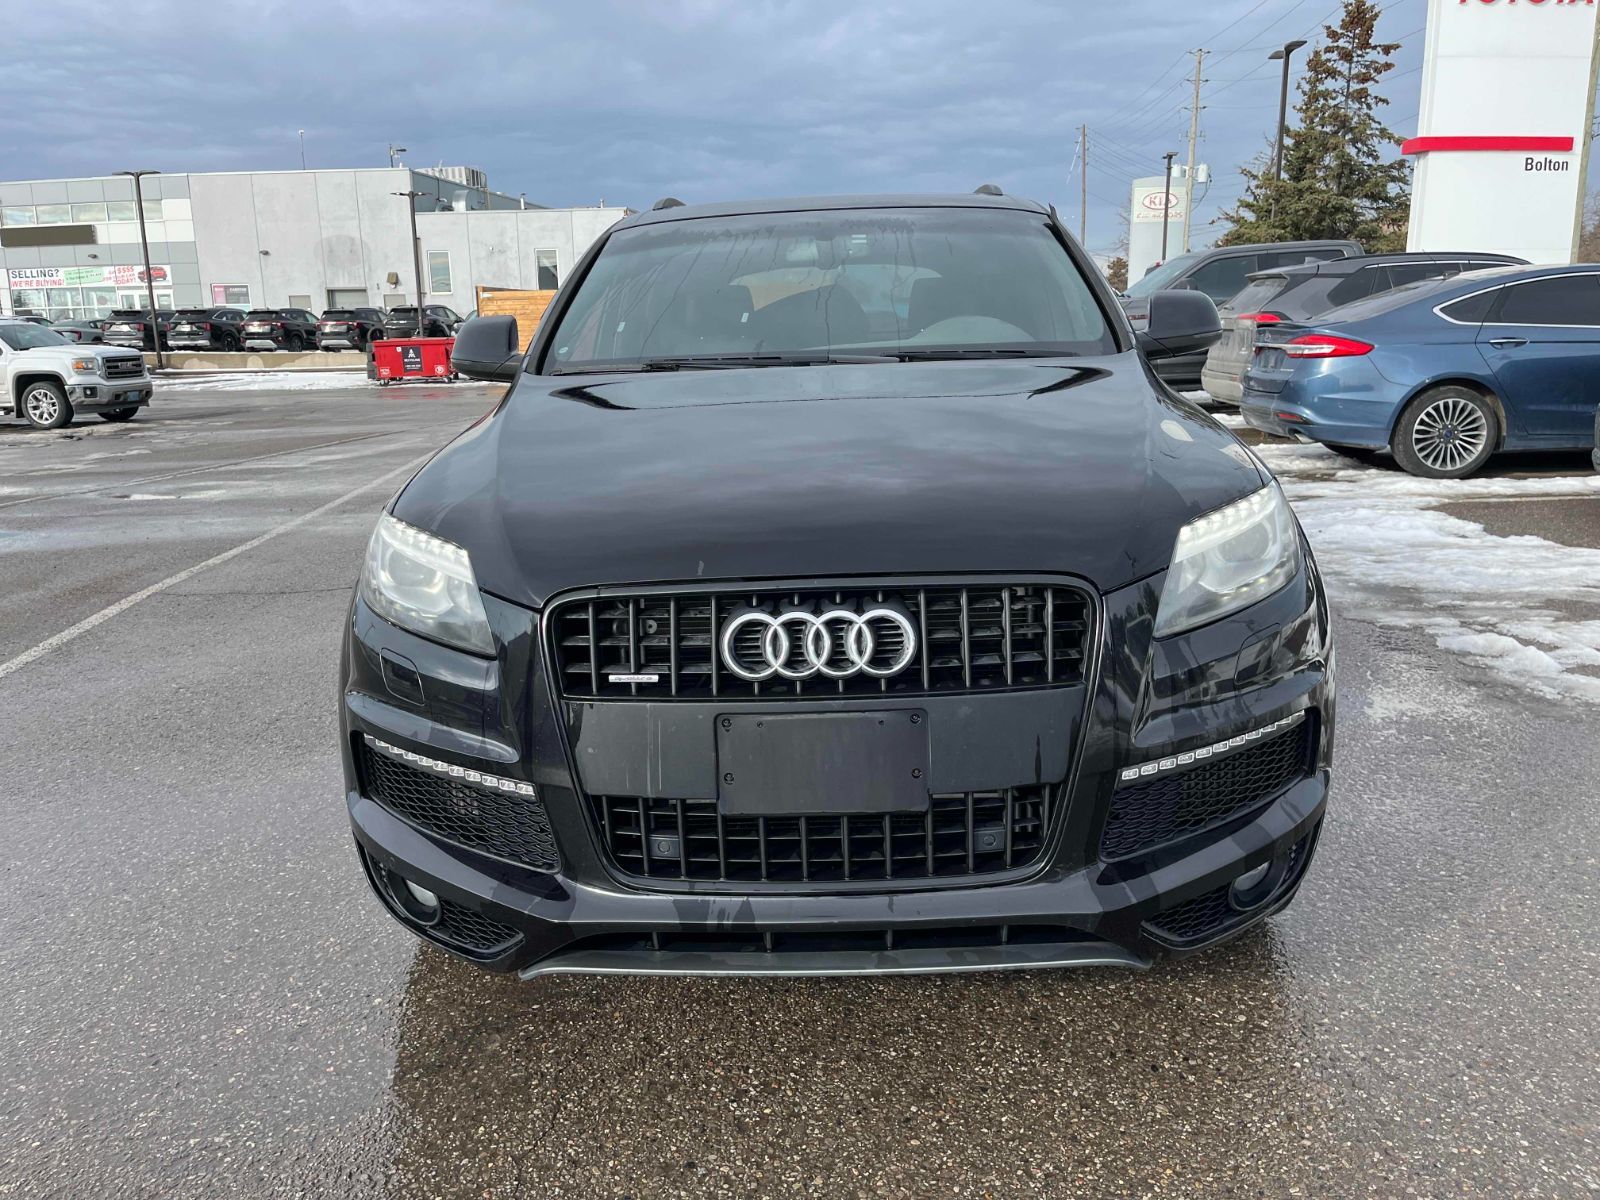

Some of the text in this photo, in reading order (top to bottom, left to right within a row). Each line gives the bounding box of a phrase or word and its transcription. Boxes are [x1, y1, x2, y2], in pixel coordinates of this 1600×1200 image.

[1525, 157, 1569, 171] Bolton
[11, 268, 60, 279] SELLING?
[11, 278, 65, 288] WE'RE BUYING!
